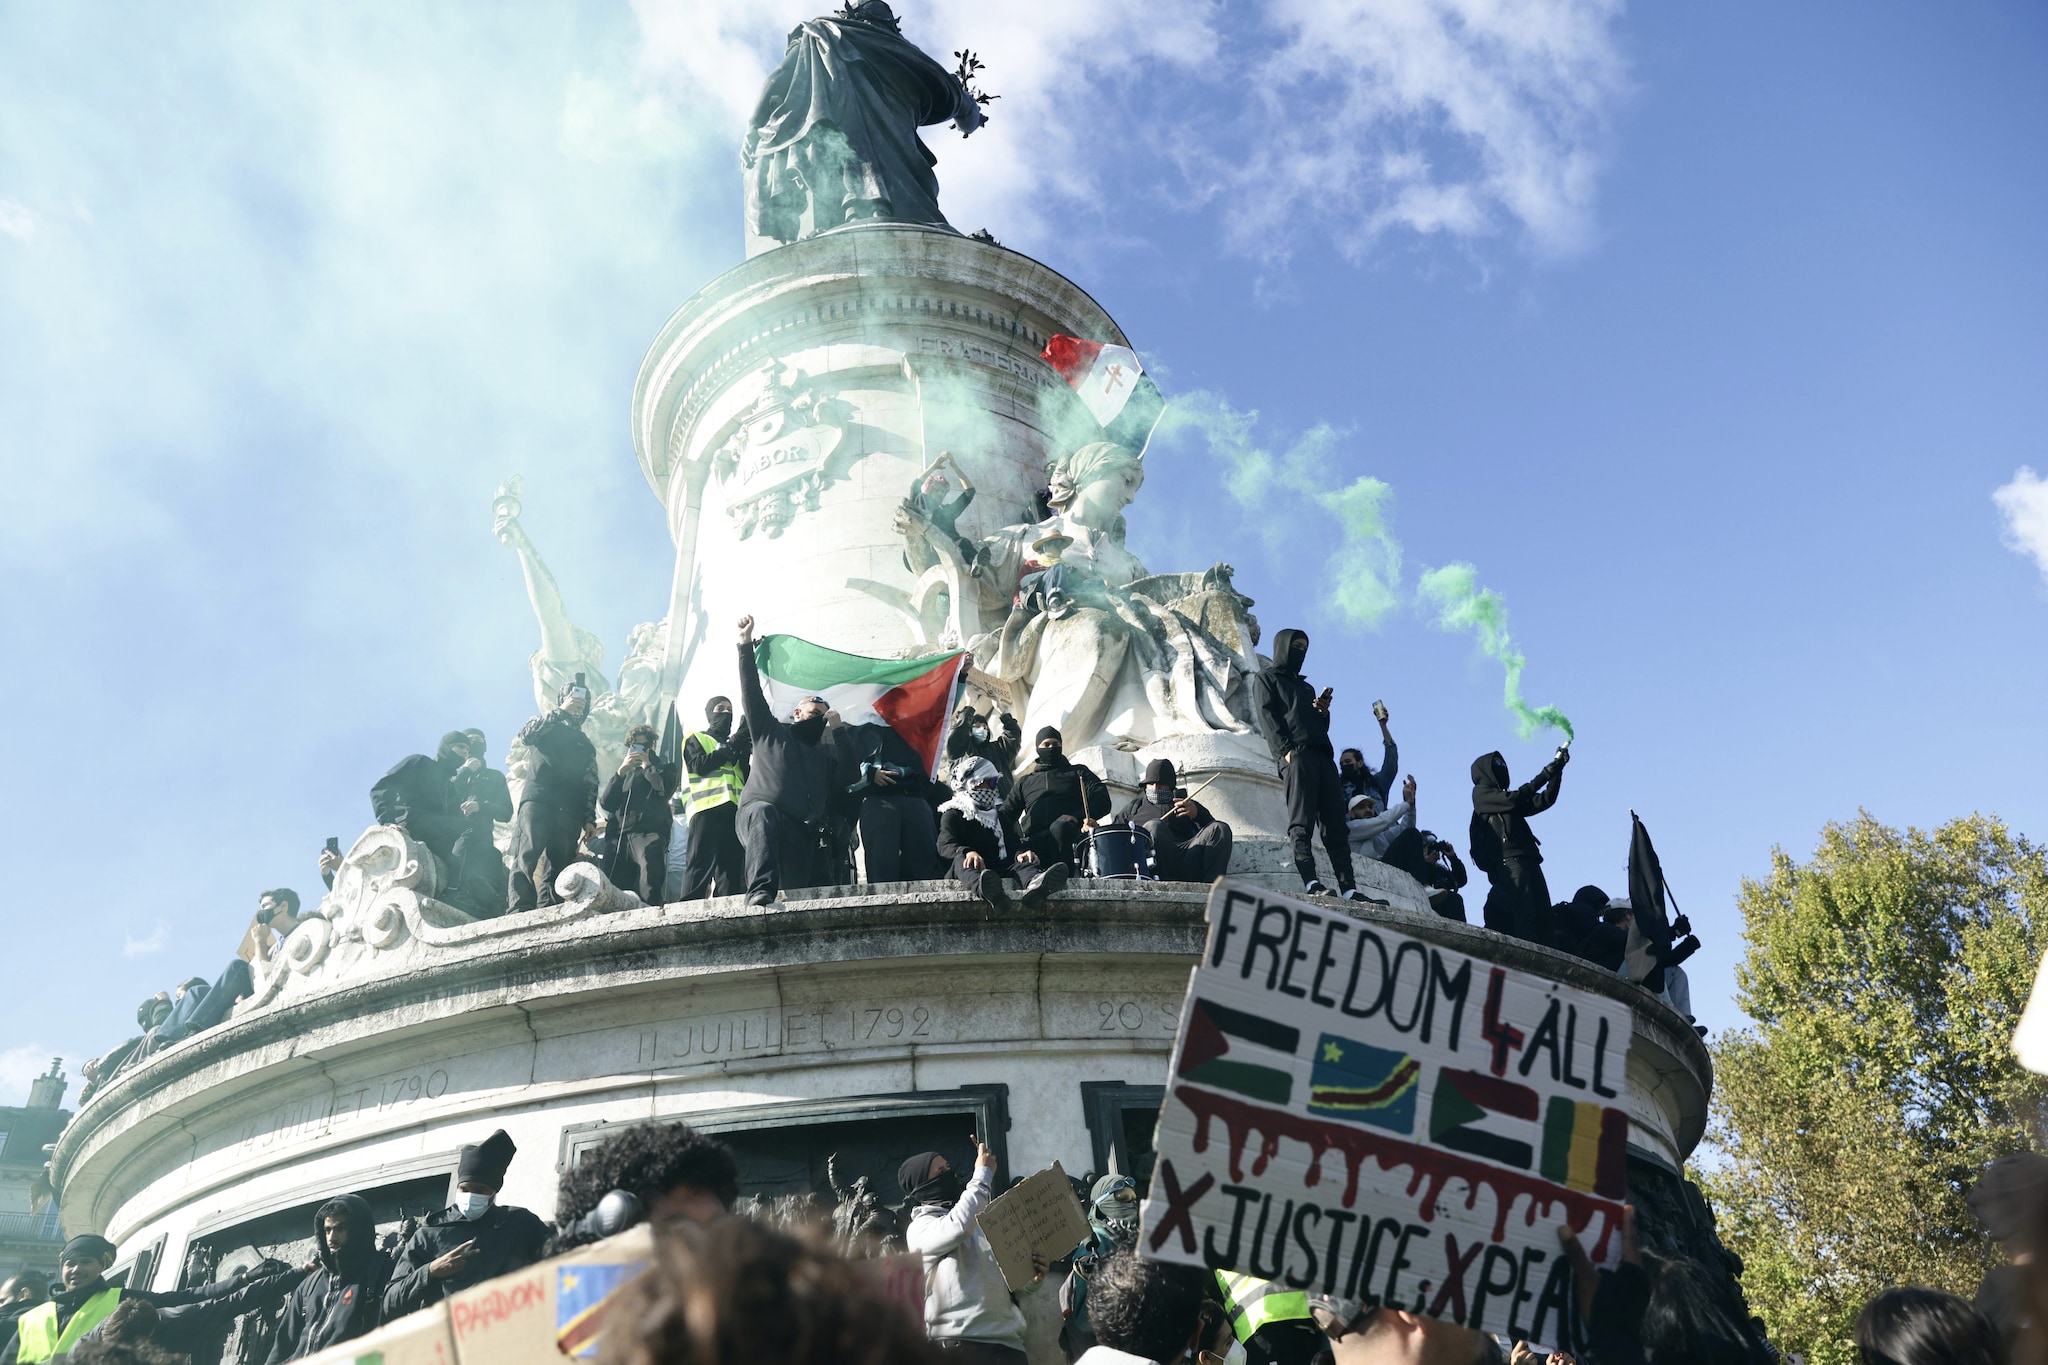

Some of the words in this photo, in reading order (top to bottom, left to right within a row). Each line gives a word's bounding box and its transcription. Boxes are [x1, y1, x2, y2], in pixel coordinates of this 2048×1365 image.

[741, 444, 808, 487] LABOR
[1098, 1001, 1143, 1030] 20
[1212, 890, 1471, 1053] FREEDOM
[1481, 966, 1525, 1078] 4
[1518, 998, 1617, 1099] ALL
[637, 1031, 658, 1063] 11
[673, 1009, 832, 1058] JUILLET
[852, 1007, 930, 1040] 1792
[237, 1123, 258, 1157] 14
[263, 1088, 370, 1147] JUILLET
[379, 1069, 449, 1112] 1790
[452, 1276, 544, 1340] PARDON
[1469, 1245, 1588, 1350] PEA
